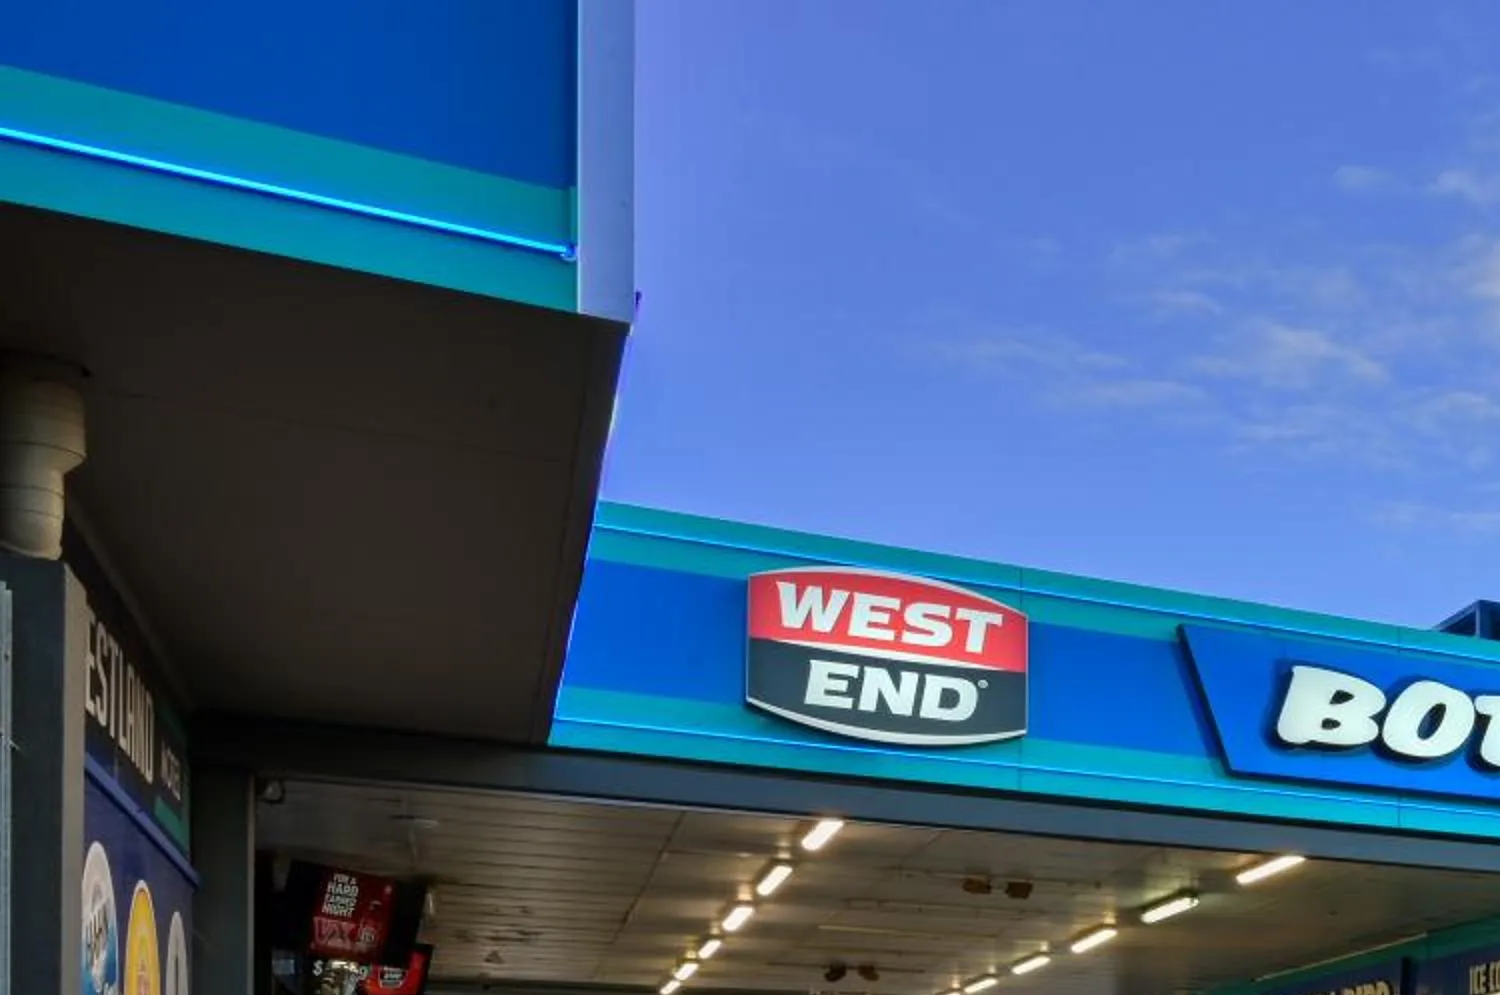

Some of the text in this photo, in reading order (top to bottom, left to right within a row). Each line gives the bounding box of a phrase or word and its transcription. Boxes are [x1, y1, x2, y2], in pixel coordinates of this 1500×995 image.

[776, 581, 1004, 654] WEST
[85, 607, 154, 785] ESTLAND
[803, 659, 980, 721] END
